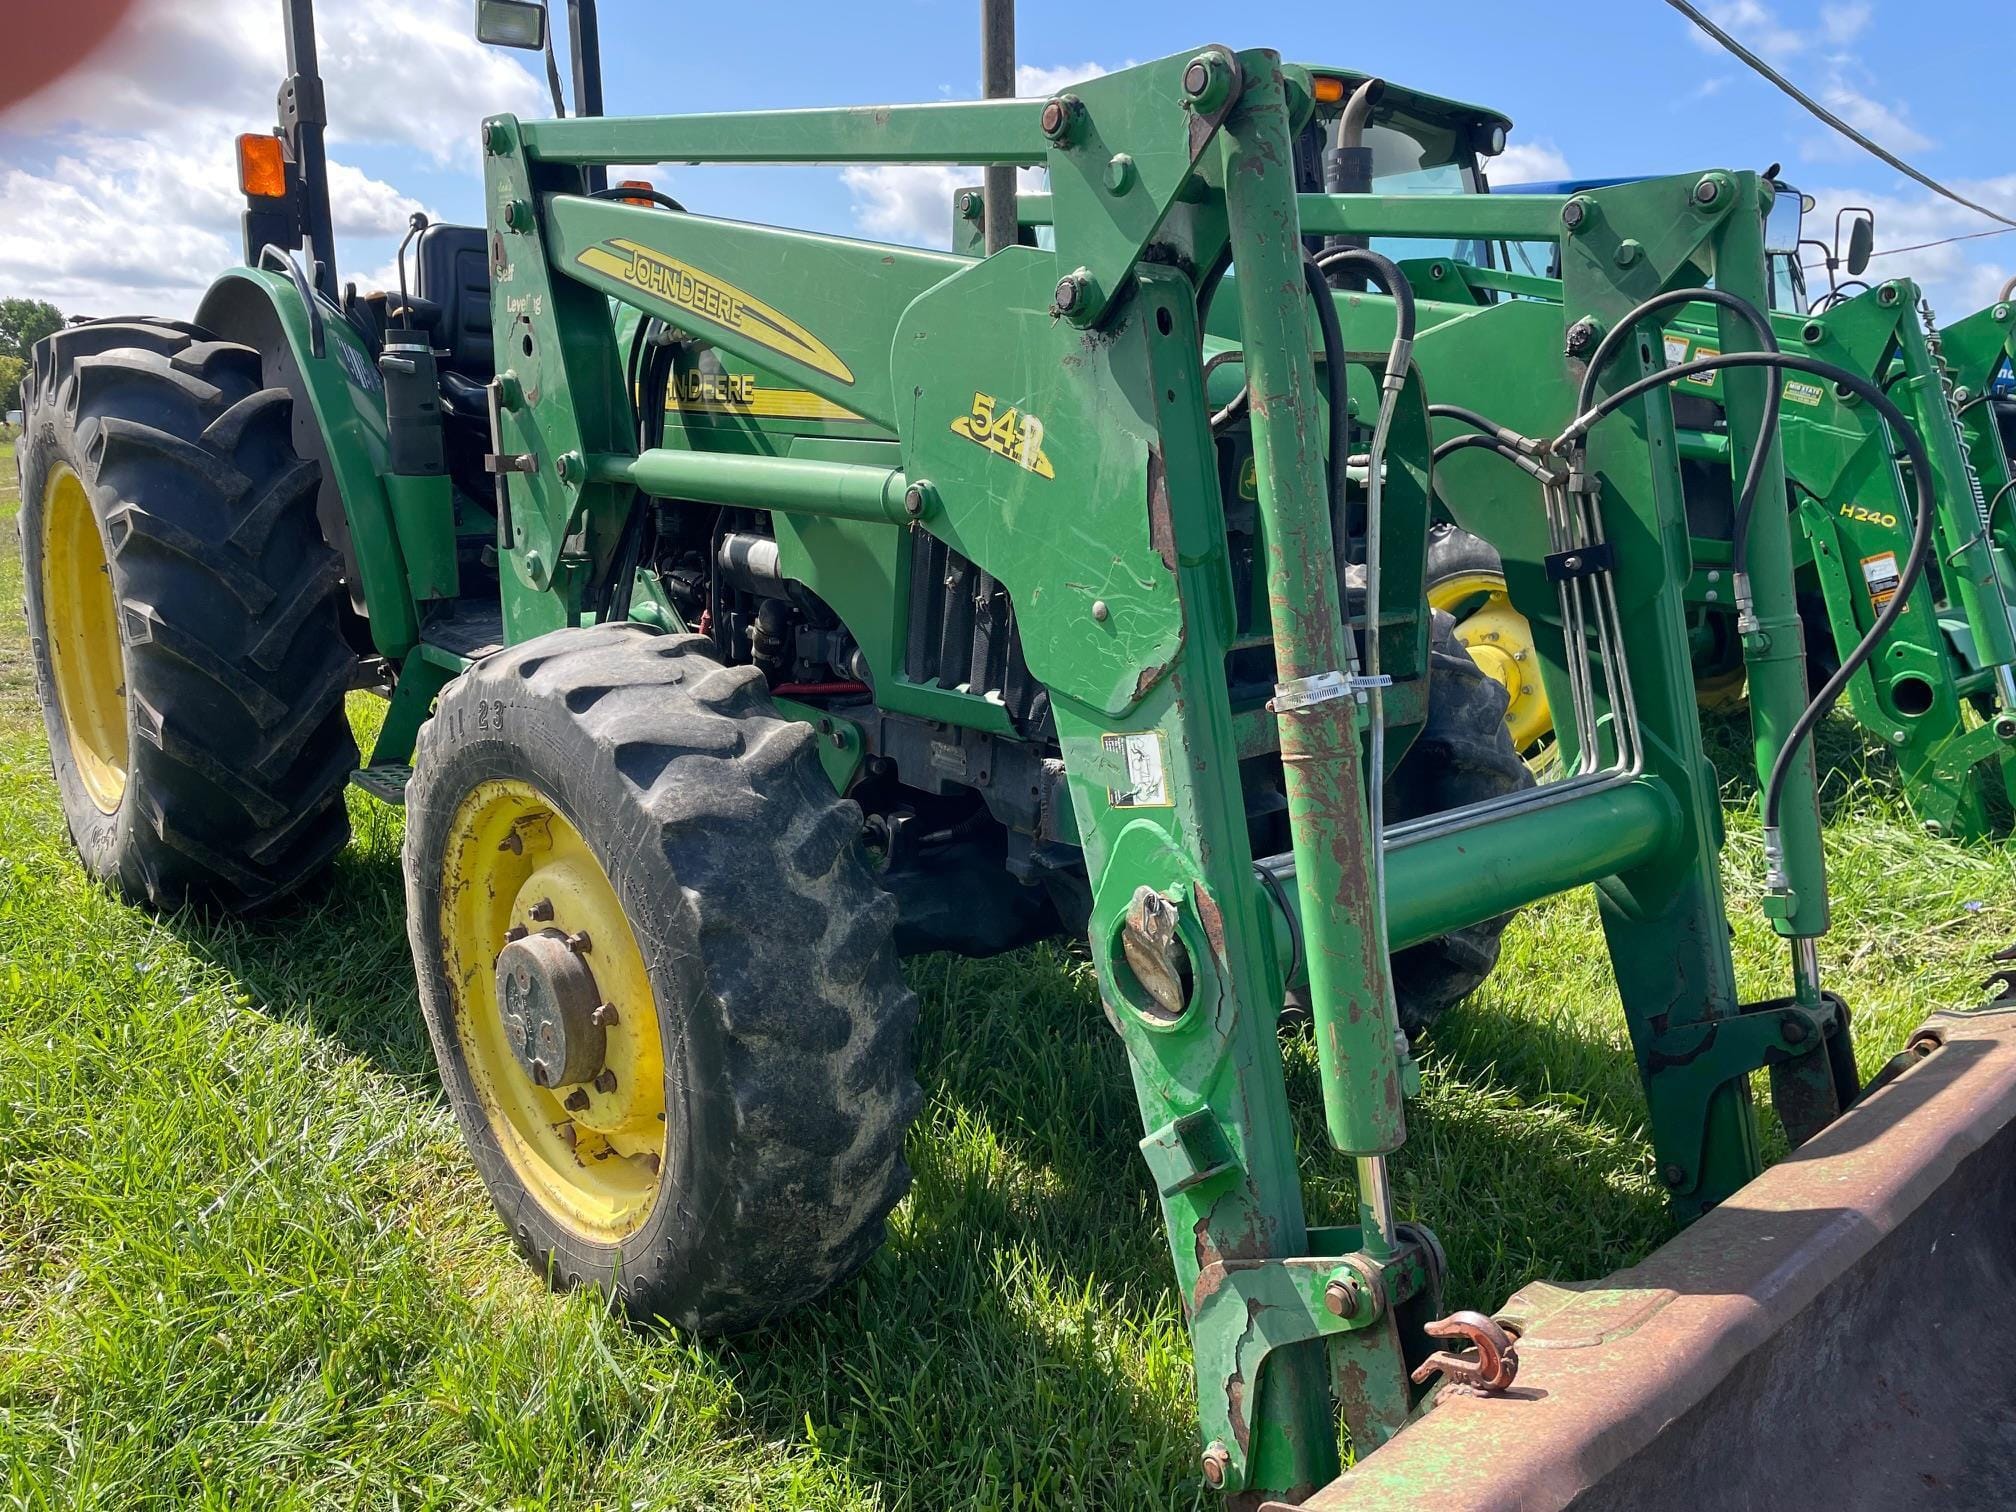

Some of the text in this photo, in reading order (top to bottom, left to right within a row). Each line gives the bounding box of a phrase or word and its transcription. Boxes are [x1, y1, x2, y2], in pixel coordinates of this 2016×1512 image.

[496, 263, 515, 282] Self
[687, 367, 756, 405] DEERE
[1839, 503, 1897, 528] H240
